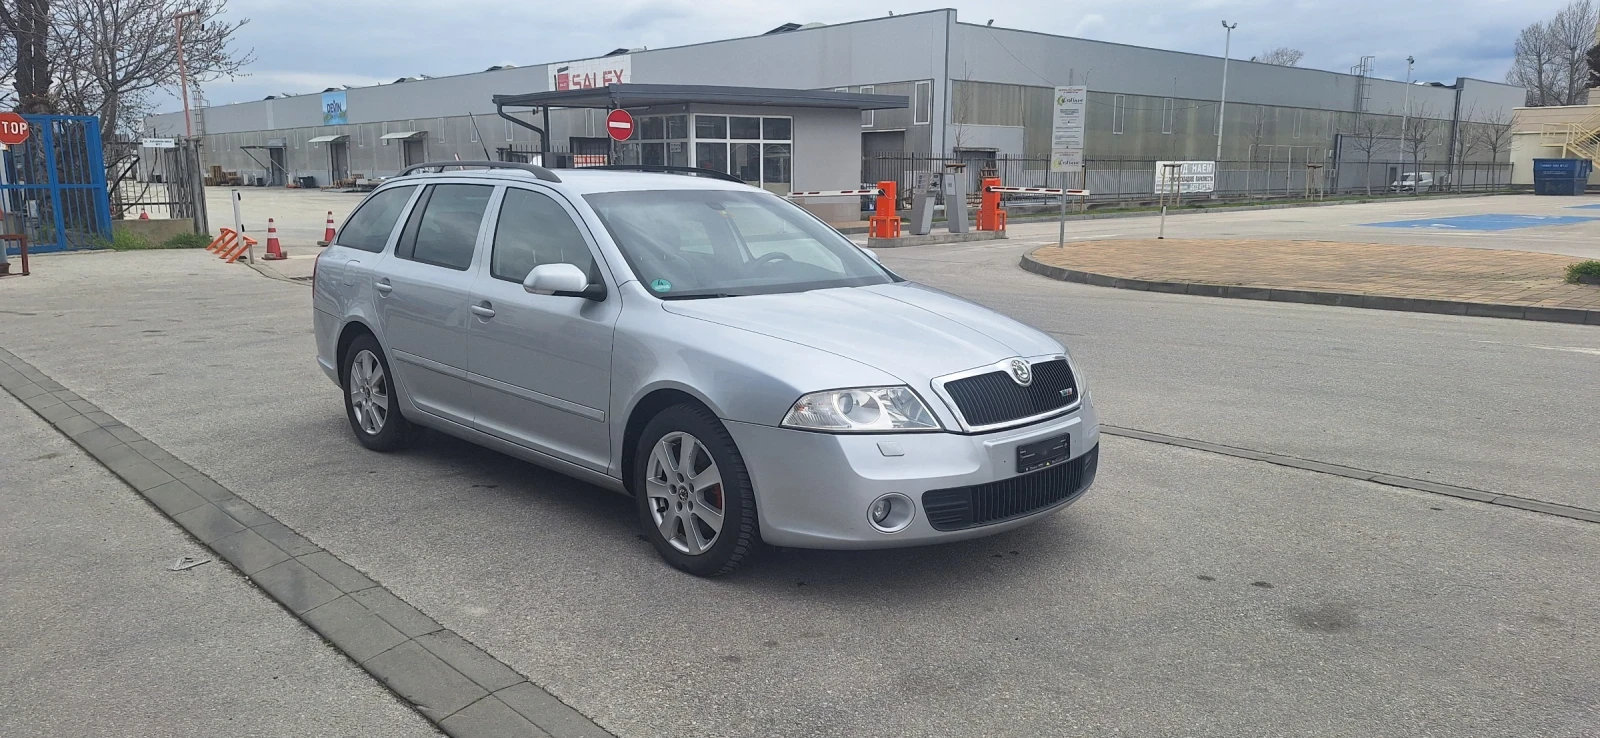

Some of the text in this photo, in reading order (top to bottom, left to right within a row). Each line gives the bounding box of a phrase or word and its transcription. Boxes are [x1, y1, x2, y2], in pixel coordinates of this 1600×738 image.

[572, 69, 624, 89] SALEX
[326, 101, 342, 113] DEVIN
[1, 121, 28, 135] TOP
[1191, 163, 1213, 173] НАЕМ
